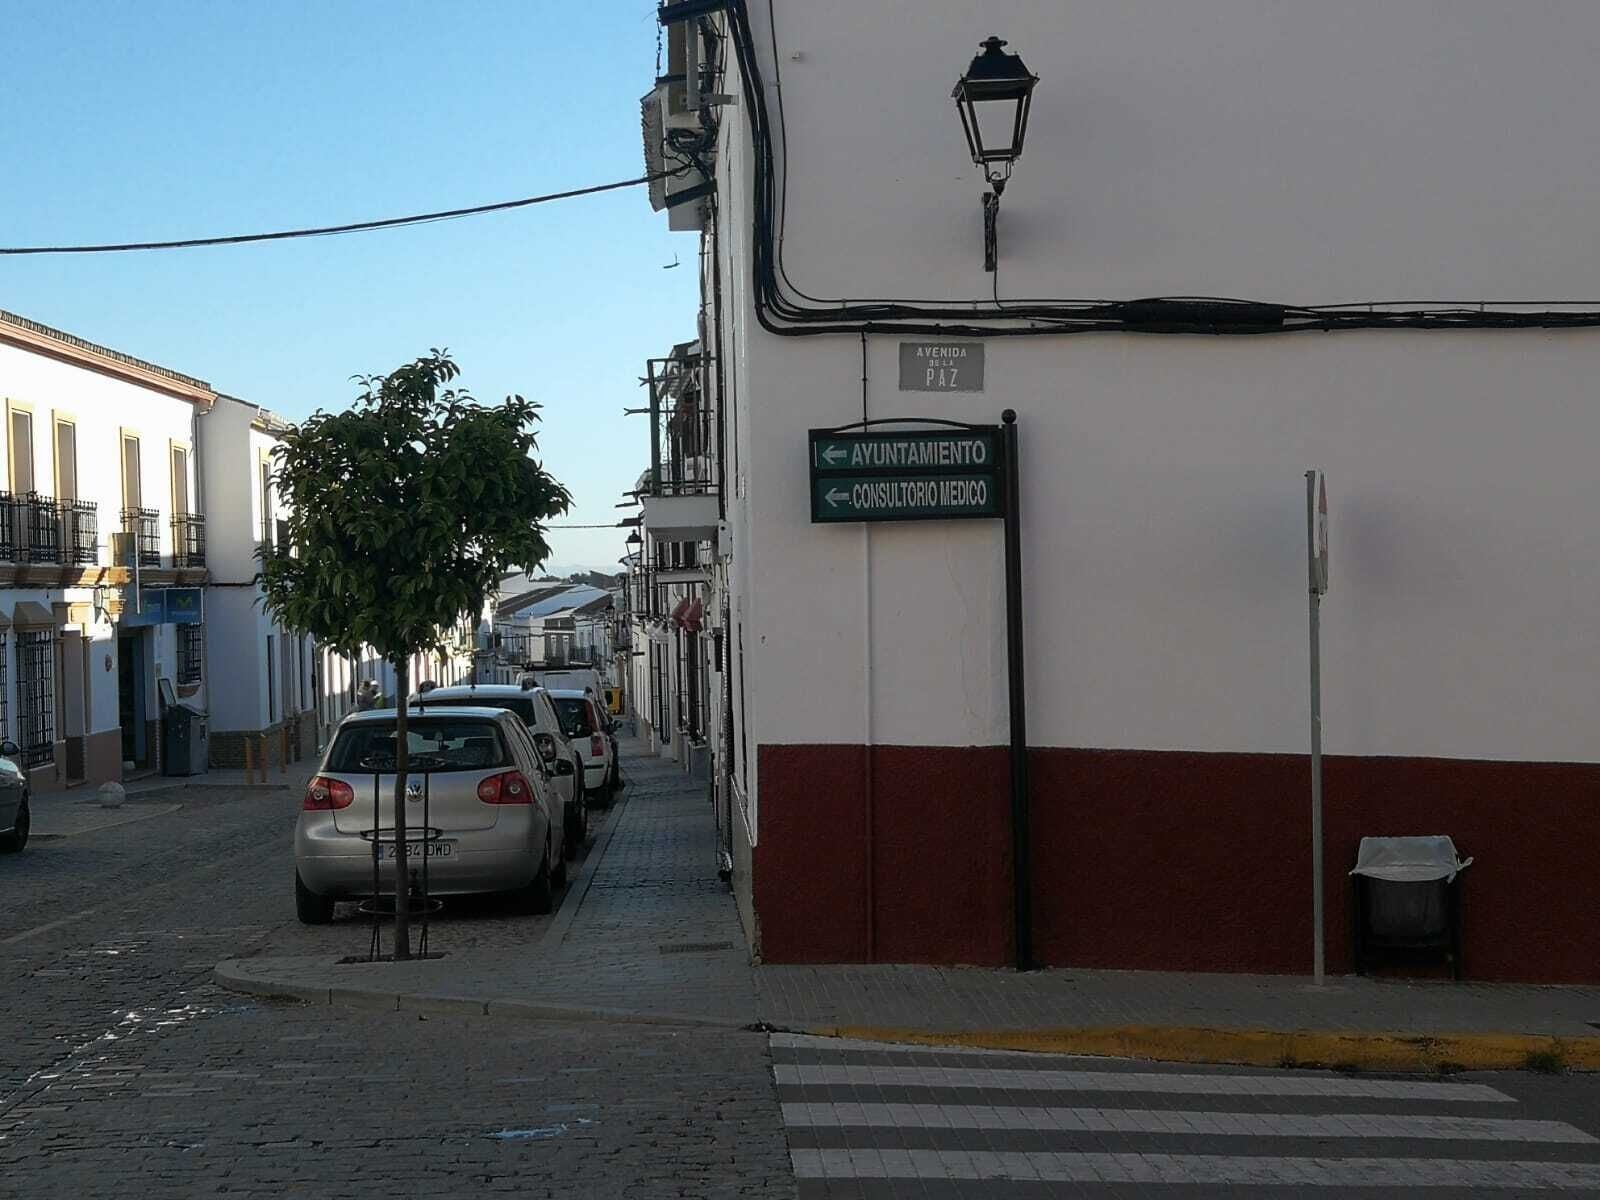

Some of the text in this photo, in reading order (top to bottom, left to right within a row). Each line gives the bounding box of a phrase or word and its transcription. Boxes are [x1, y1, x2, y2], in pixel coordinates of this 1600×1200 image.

[917, 347, 967, 358] AVENIDA
[929, 359, 939, 367] DE
[926, 368, 958, 387] PAZ
[851, 440, 986, 465] AYUNTAMIENTO
[852, 480, 987, 508] CONSULTORIO MEDICO
[388, 844, 420, 858] 284
